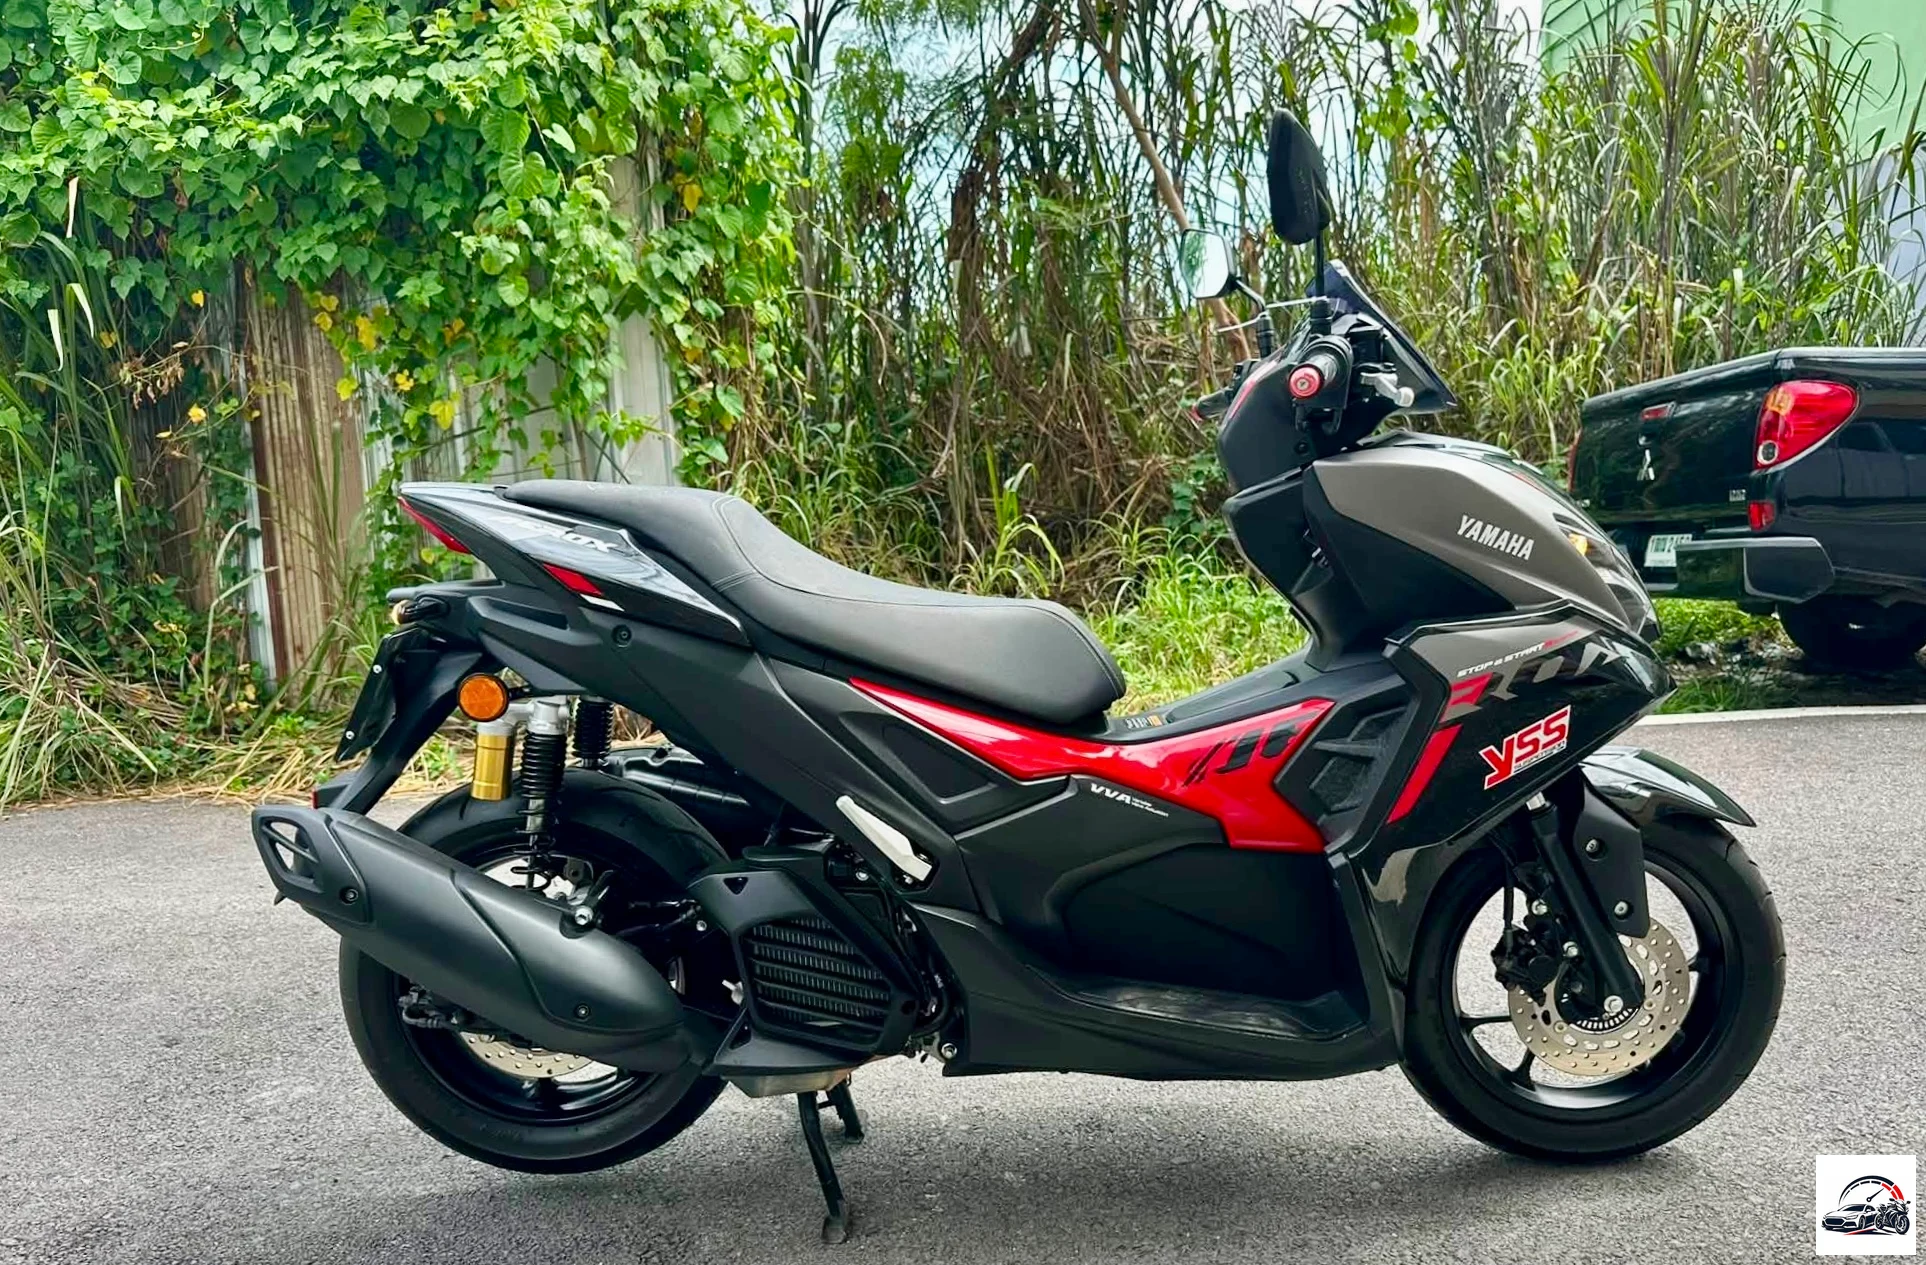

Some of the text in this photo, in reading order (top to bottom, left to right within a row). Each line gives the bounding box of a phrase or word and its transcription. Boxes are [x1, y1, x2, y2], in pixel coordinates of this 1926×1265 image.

[1457, 514, 1534, 560] YAMAHA
[1480, 706, 1570, 789] YSS
[1091, 782, 1131, 804] VVA
